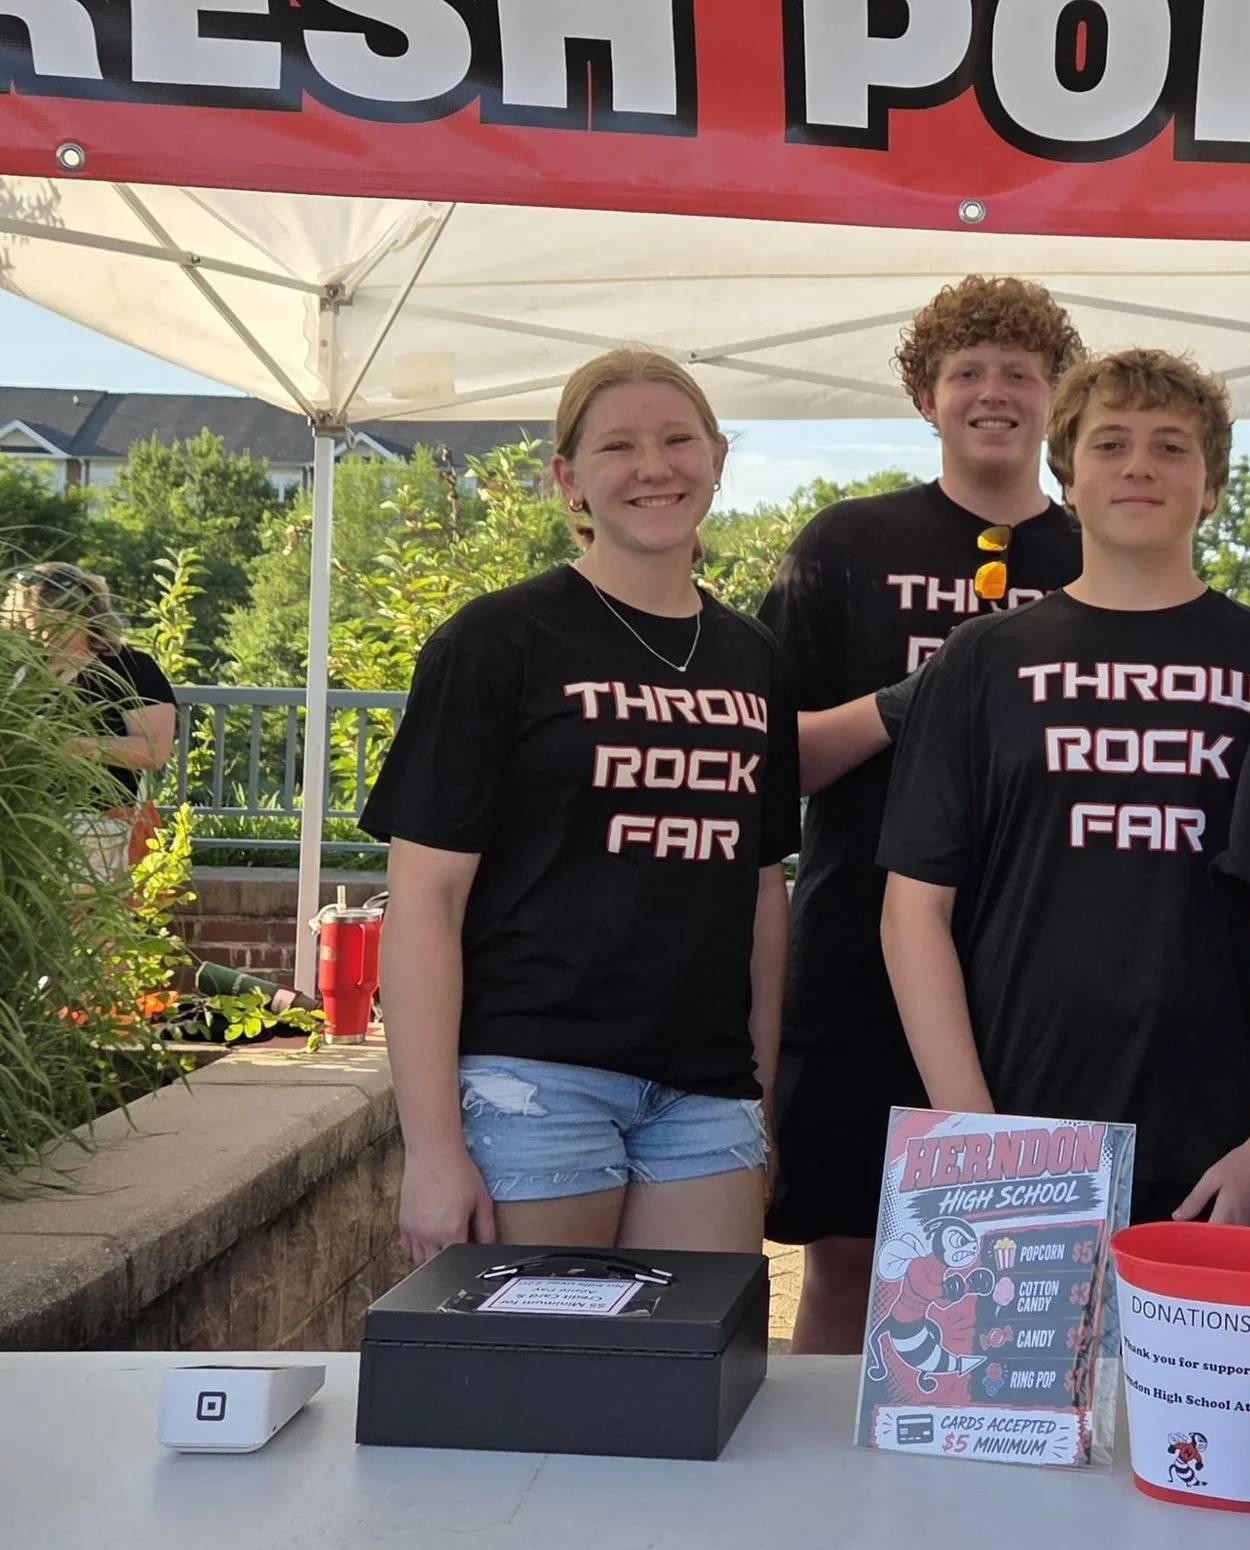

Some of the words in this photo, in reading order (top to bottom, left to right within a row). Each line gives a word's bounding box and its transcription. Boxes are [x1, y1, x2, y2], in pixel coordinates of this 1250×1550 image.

[563, 681, 768, 734] THROW
[1044, 726, 1235, 780] ROCK
[592, 744, 761, 793] ROCK
[607, 813, 741, 861] FAR
[1070, 803, 1206, 853] FAR
[900, 1124, 1107, 1193] HERNDON
[939, 1187, 996, 1215] HIGH
[996, 1181, 1080, 1208] SCHOOL
[1019, 1243, 1066, 1262] POPCORN
[1072, 1241, 1094, 1263] $5
[1018, 1280, 1060, 1297] COTTON
[1017, 1294, 1053, 1313] CANDY
[1016, 1329, 1056, 1349] CANDY
[1123, 1336, 1151, 1360] Thank
[1153, 1353, 1176, 1366] you
[1179, 1357, 1200, 1370] for
[1010, 1370, 1034, 1389] RING
[1035, 1369, 1057, 1389] POP
[1153, 1388, 1182, 1404] High
[1185, 1395, 1231, 1411] School
[940, 1415, 984, 1431] CARDS
[986, 1417, 1057, 1435] ACCEPTED
[941, 1432, 969, 1452] $5
[972, 1437, 1048, 1457] MINIMUM
